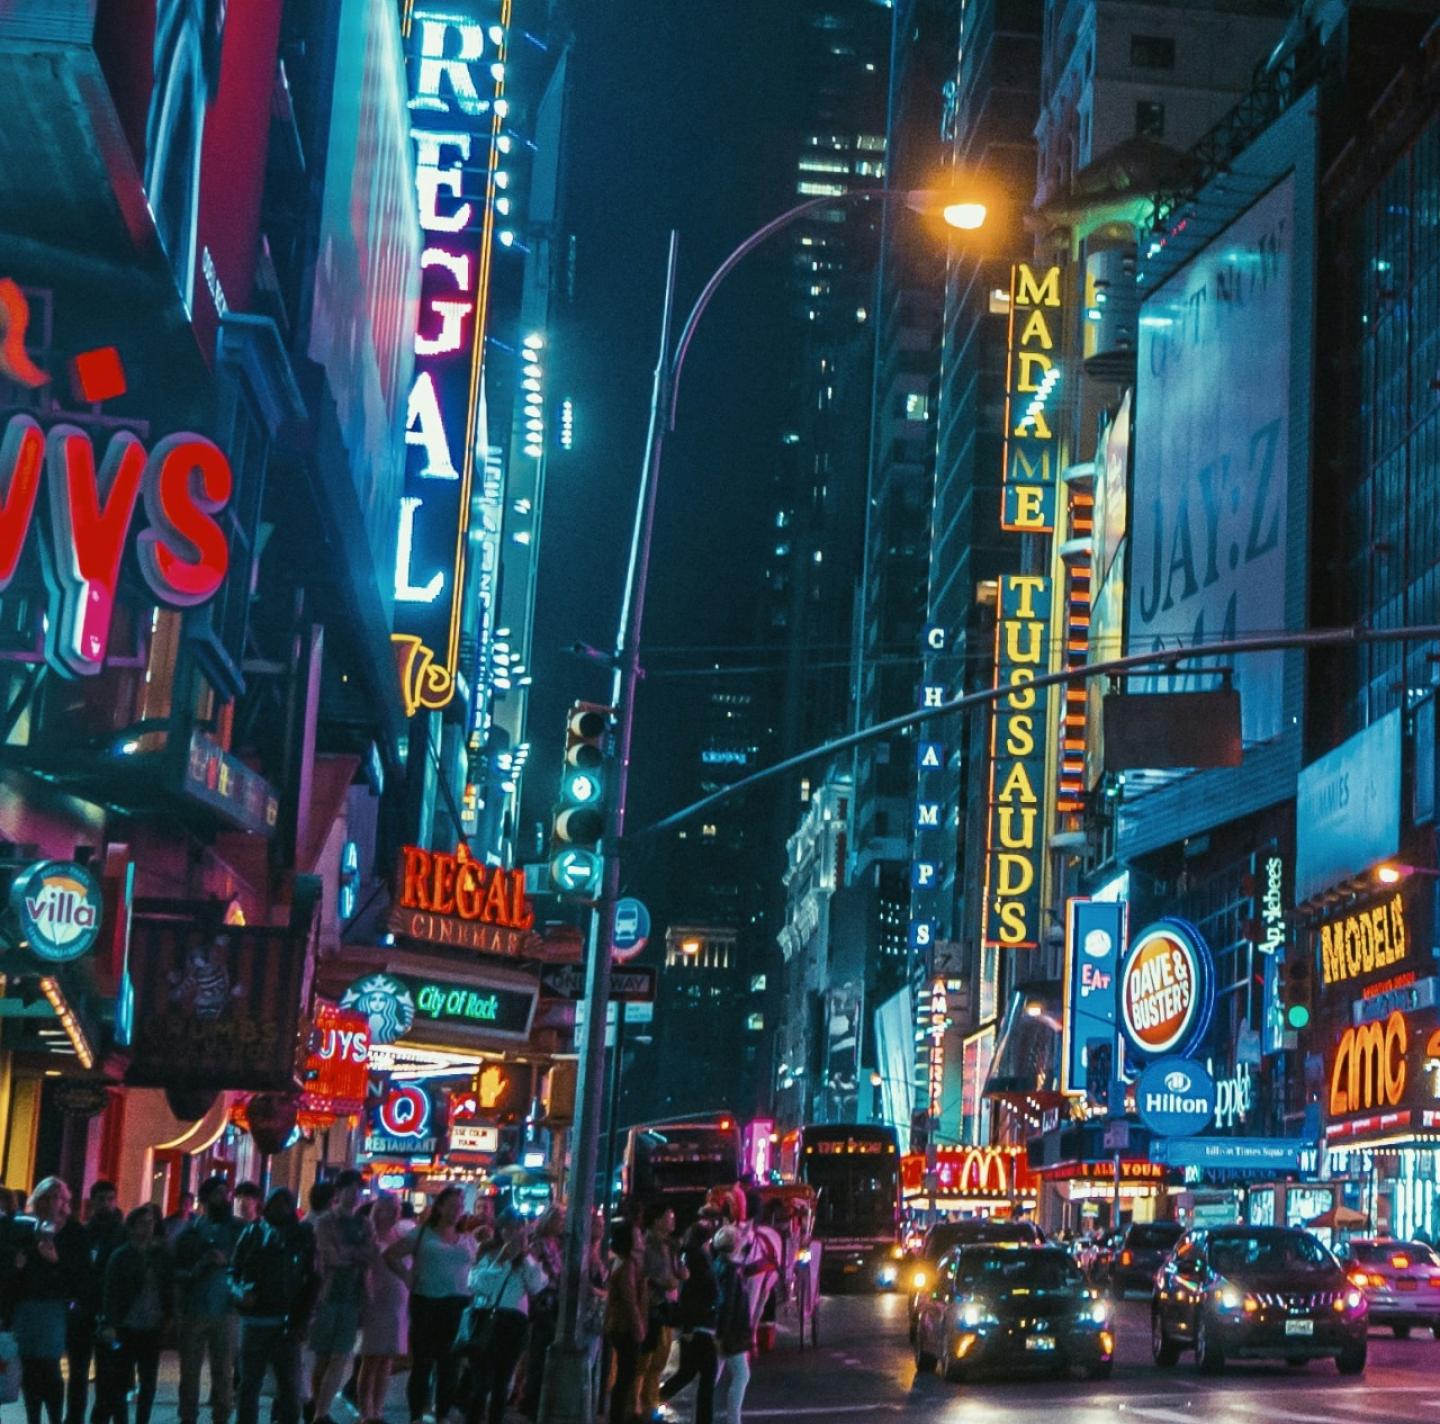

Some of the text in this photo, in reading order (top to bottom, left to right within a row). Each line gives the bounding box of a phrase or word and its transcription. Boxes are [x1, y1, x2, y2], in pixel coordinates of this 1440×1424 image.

[394, 11, 490, 603] REGAL
[1013, 263, 1060, 527] MADAME
[916, 627, 946, 946] CHAMPS
[995, 577, 1044, 943] TUSSAUD'S
[25, 891, 97, 928] villa
[401, 843, 535, 931] REGAL
[411, 913, 521, 957] CINEMAS
[1131, 949, 1188, 1003] DAVE &
[417, 986, 446, 1018] City
[465, 993, 498, 1020] Rock
[1132, 980, 1190, 1031] BUSTER'S
[379, 1086, 431, 1138] Q
[1146, 1093, 1208, 1114] Hilton
